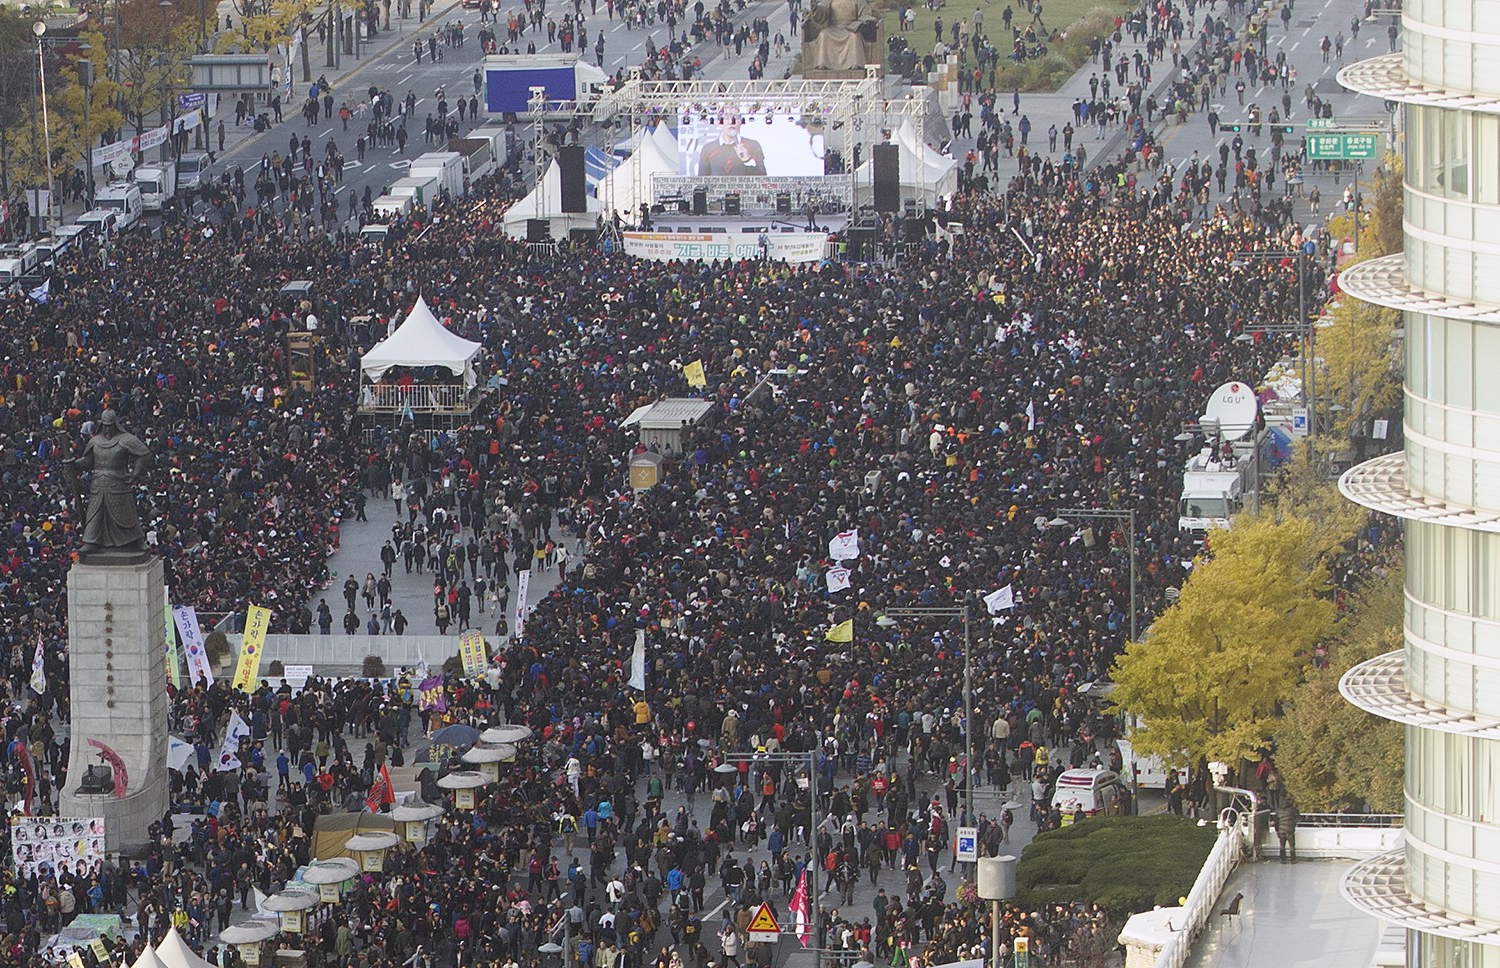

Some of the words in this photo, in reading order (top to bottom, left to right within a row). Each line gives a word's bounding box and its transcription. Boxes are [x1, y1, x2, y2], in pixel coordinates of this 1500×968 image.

[1222, 395, 1234, 404] LG
[180, 610, 194, 640] 손가락
[249, 609, 263, 640] 손가락
